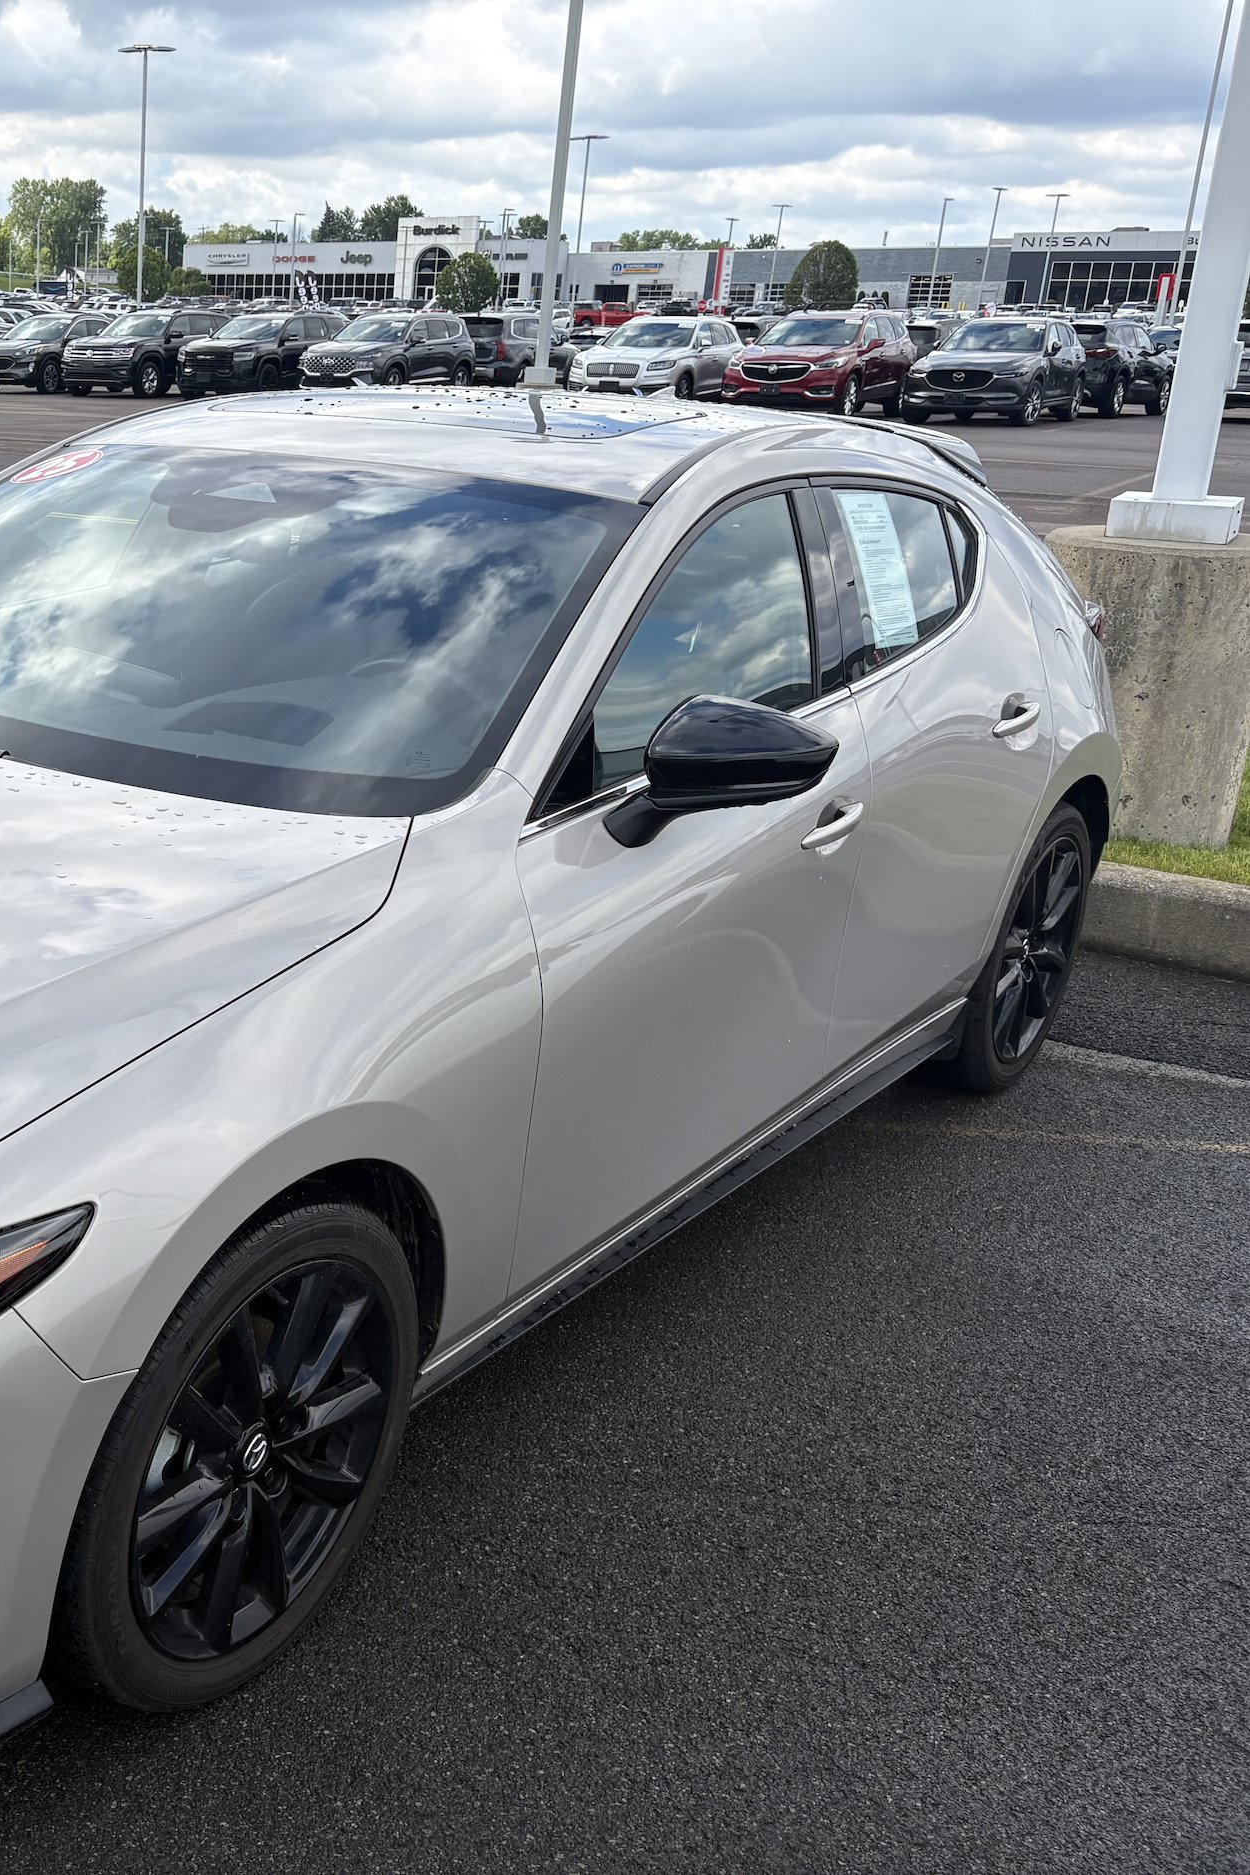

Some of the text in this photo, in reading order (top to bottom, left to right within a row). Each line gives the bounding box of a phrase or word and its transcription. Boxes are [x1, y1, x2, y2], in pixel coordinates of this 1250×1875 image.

[413, 224, 460, 236] Burdick
[1021, 235, 1111, 248] NISSAN
[272, 255, 316, 263] DODGE
[340, 250, 373, 266] Jeep
